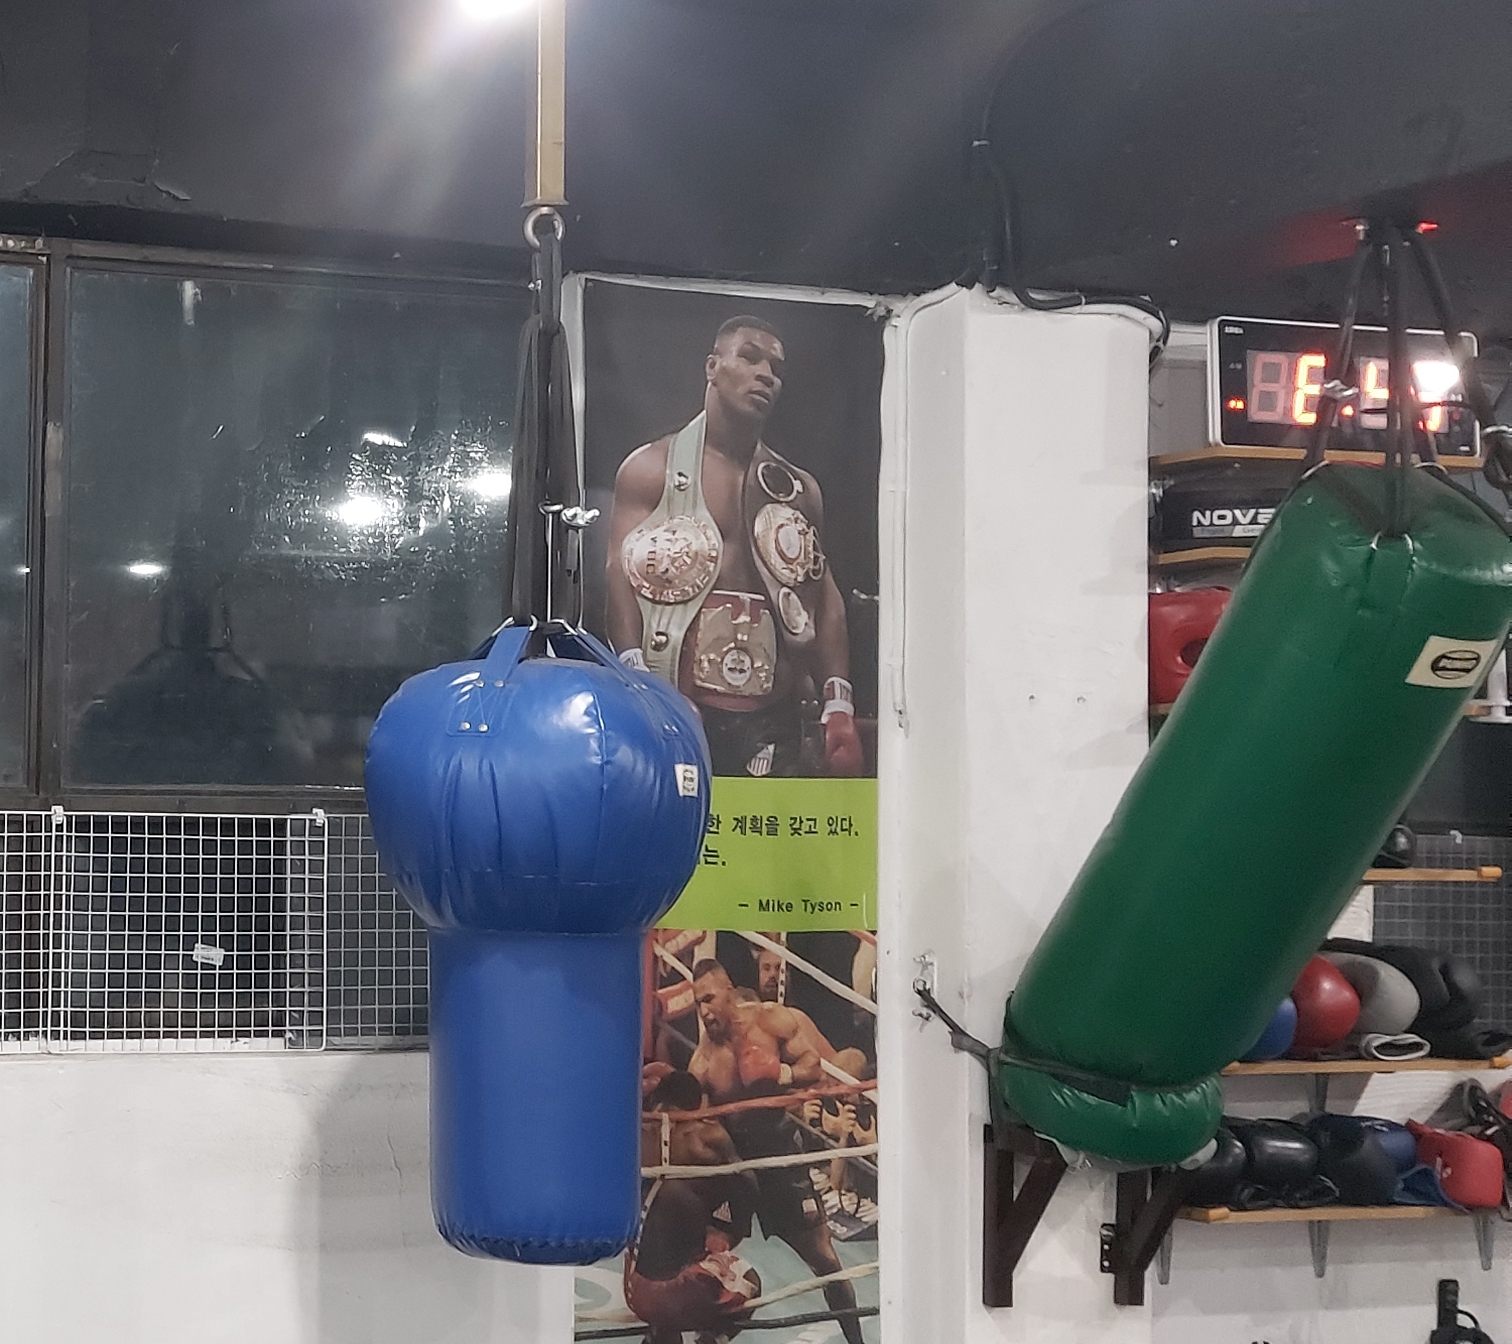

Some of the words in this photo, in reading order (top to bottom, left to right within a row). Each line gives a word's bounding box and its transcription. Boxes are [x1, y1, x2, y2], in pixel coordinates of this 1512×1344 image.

[732, 815, 780, 837] 계획을
[789, 815, 818, 837] 갖고
[827, 815, 859, 837] 있다.
[758, 899, 793, 913] Mike
[801, 899, 842, 915] Tyson
